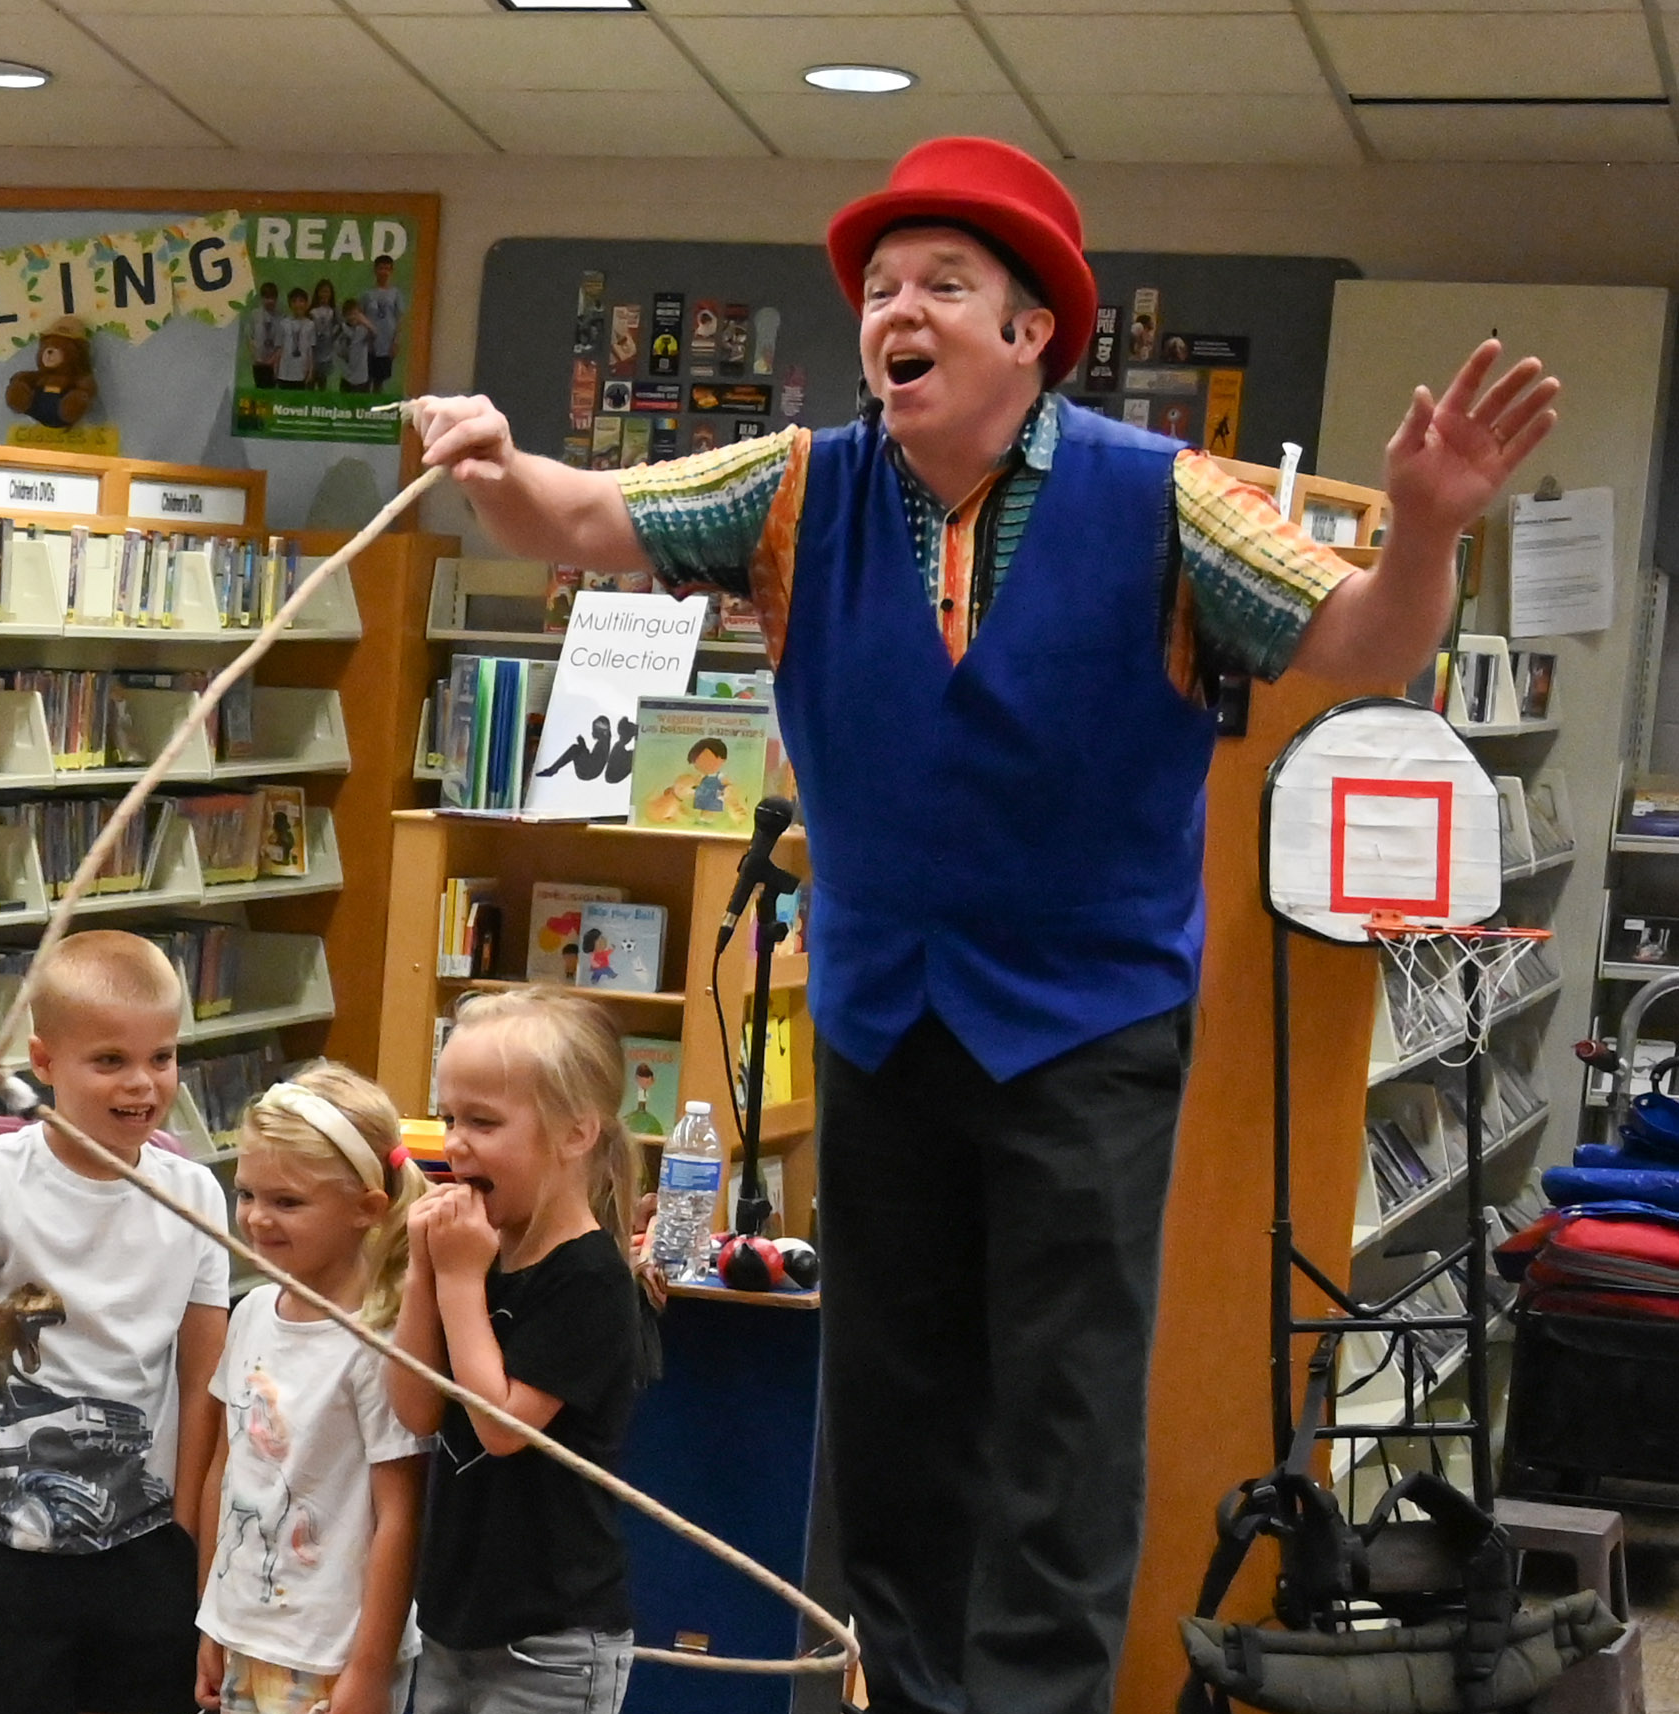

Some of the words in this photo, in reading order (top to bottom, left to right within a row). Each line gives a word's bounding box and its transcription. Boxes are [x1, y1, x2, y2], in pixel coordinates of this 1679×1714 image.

[255, 216, 408, 262] READ
[272, 404, 308, 417] Novel
[9, 479, 38, 502] Children's
[39, 481, 55, 503] DVDs
[573, 612, 697, 639] Multilingual
[570, 647, 680, 672] Collection
